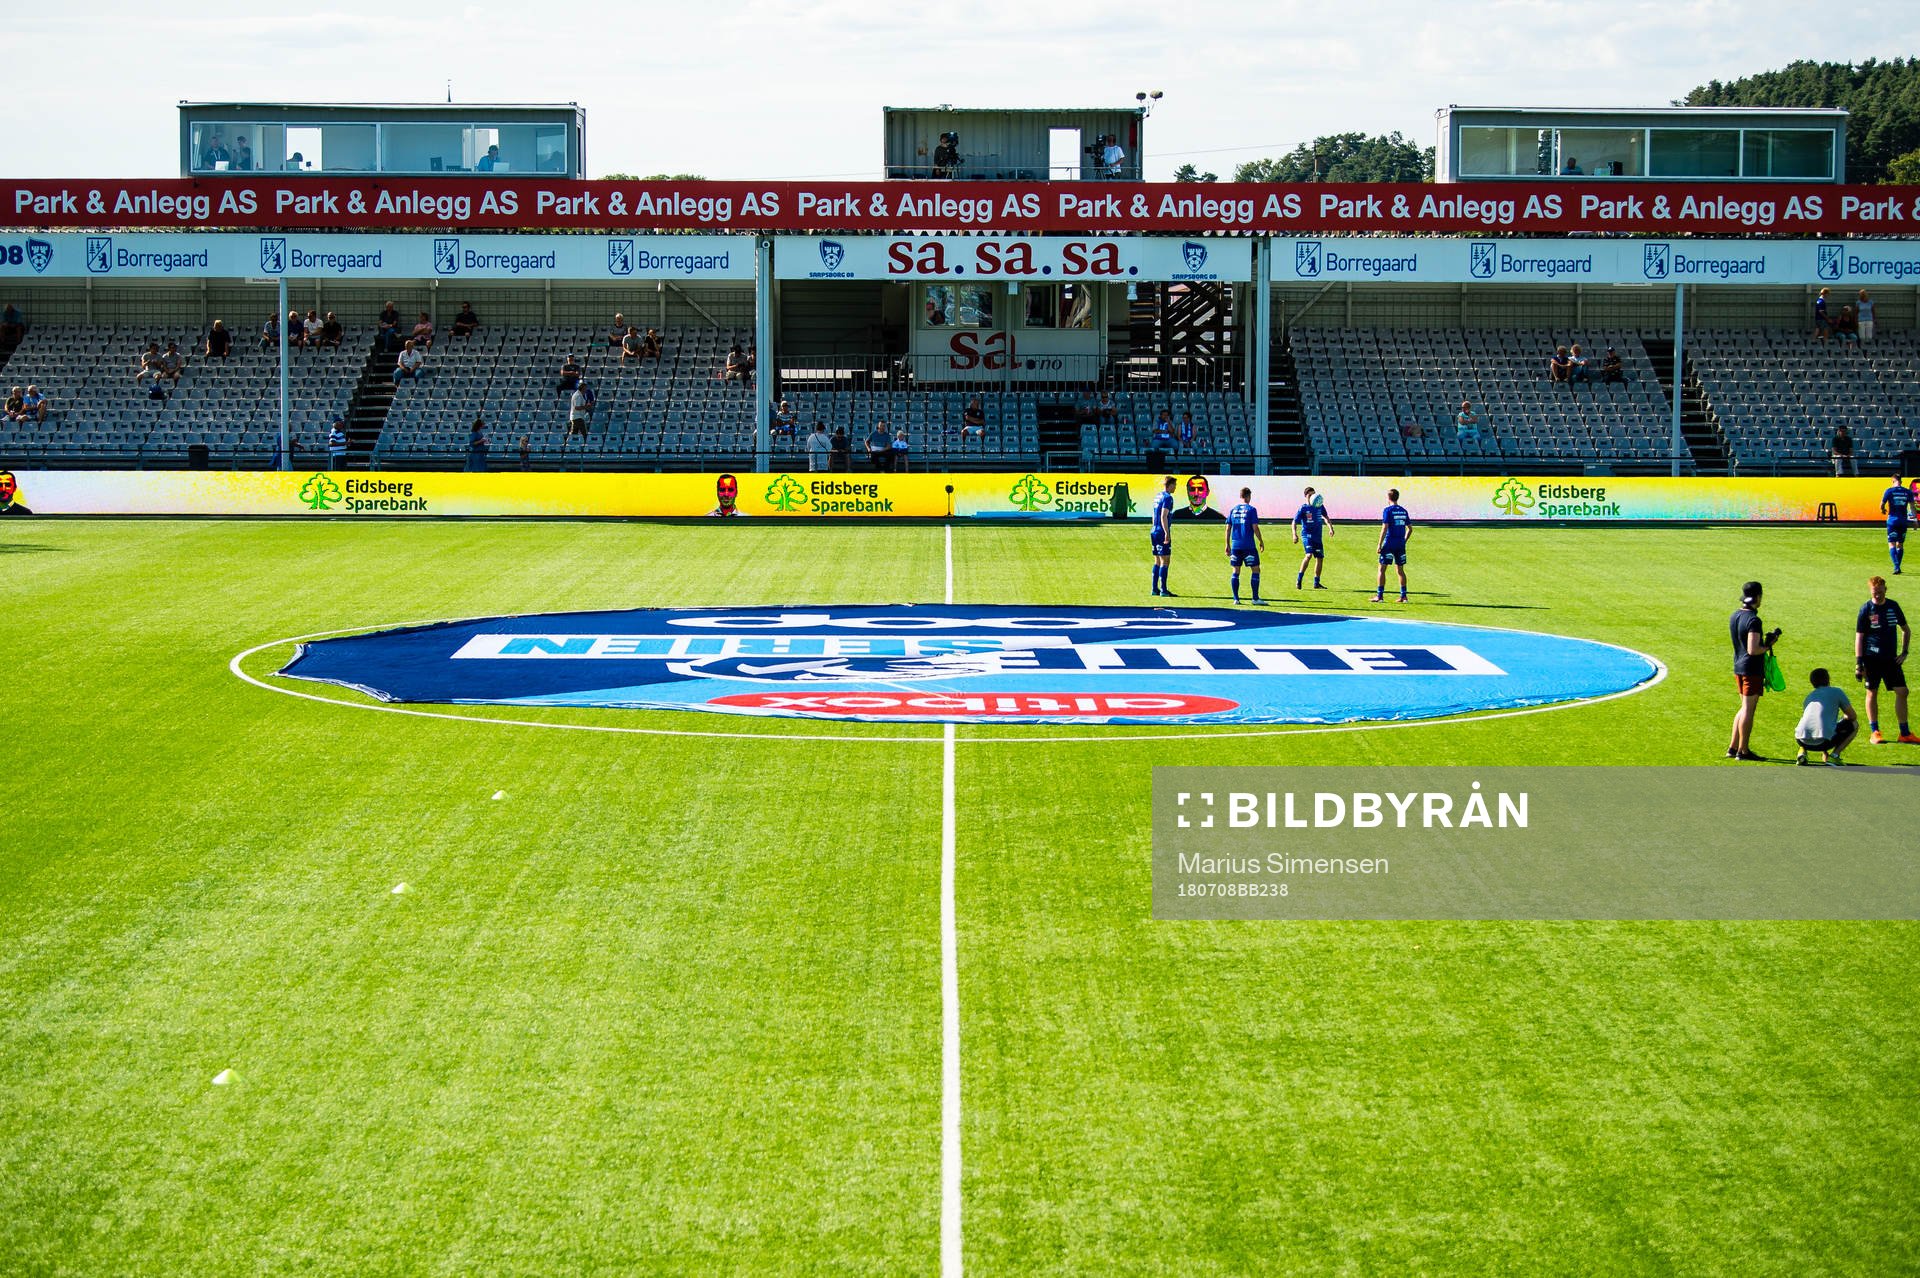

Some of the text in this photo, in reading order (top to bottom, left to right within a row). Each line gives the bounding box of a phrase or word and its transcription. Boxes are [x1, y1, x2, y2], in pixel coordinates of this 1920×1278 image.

[16, 190, 257, 220] Park & Anlegg AS
[277, 190, 518, 220] Park & Anlegg AS
[538, 191, 779, 221] Park & Anlegg AS
[799, 193, 1040, 223] Park & Anlegg AS
[1060, 194, 1301, 223] Park & Anlegg AS
[1320, 194, 1562, 224] Park & Anlegg AS
[1581, 195, 1822, 225] Park & Anlegg AS
[1842, 196, 1904, 220] Park
[118, 249, 207, 272] Borregaard
[292, 249, 381, 272] Borregaard
[466, 250, 555, 273] Borregaard
[639, 251, 728, 274] Borregaard
[1327, 253, 1416, 276] Borregaard
[1502, 254, 1591, 277] Borregaard
[1675, 255, 1764, 278] Borregaard
[346, 480, 412, 496] Eidsberg
[811, 481, 878, 498] Eidsberg
[1056, 481, 1113, 495] Eidsber
[1539, 485, 1606, 501] Eidsberg
[346, 497, 428, 512] Sparebank
[811, 498, 893, 513] Sparebank
[1055, 498, 1136, 512] Sparebk
[1539, 502, 1620, 518] Sparebank
[666, 614, 1236, 629] coop
[498, 638, 1002, 656] SERIEN
[1000, 648, 1458, 670] ELITE
[760, 696, 1185, 711] altibox
